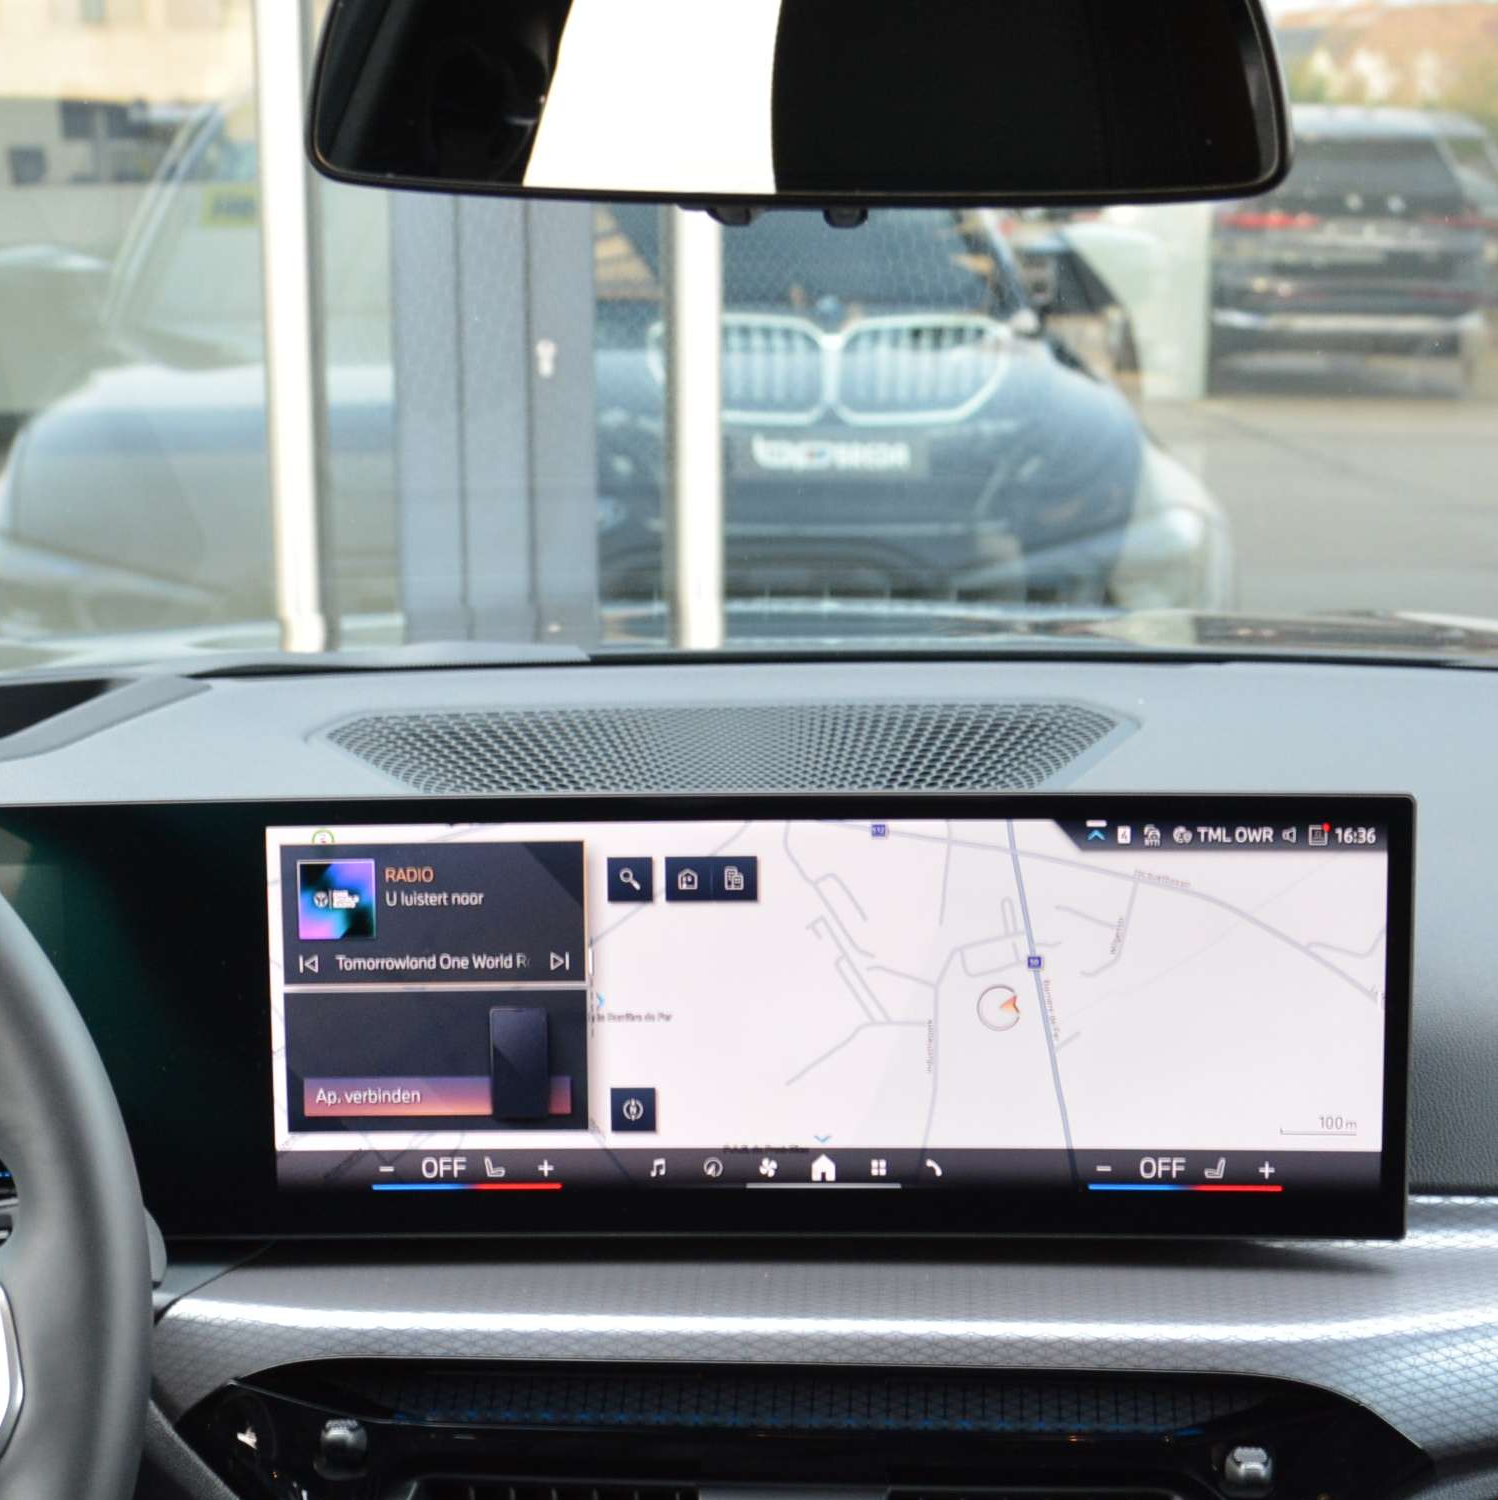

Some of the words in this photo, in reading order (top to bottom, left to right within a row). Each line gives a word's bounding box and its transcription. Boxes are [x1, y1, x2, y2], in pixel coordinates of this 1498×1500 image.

[1197, 826, 1231, 843] TML
[1235, 826, 1274, 843] OWR
[1335, 827, 1376, 844] 16:36
[385, 867, 435, 883] RADIO
[385, 891, 397, 906] U
[401, 890, 448, 906] luistert
[452, 893, 484, 906] naar
[335, 954, 436, 971] Tomorrowland
[439, 954, 469, 970] One
[472, 952, 513, 969] World
[315, 1088, 341, 1106] Ap.
[345, 1088, 421, 1105] verbinden
[1319, 1116, 1343, 1130] 100
[1345, 1121, 1358, 1130] m
[421, 1156, 467, 1178] OFF
[1139, 1156, 1186, 1179] OFF
